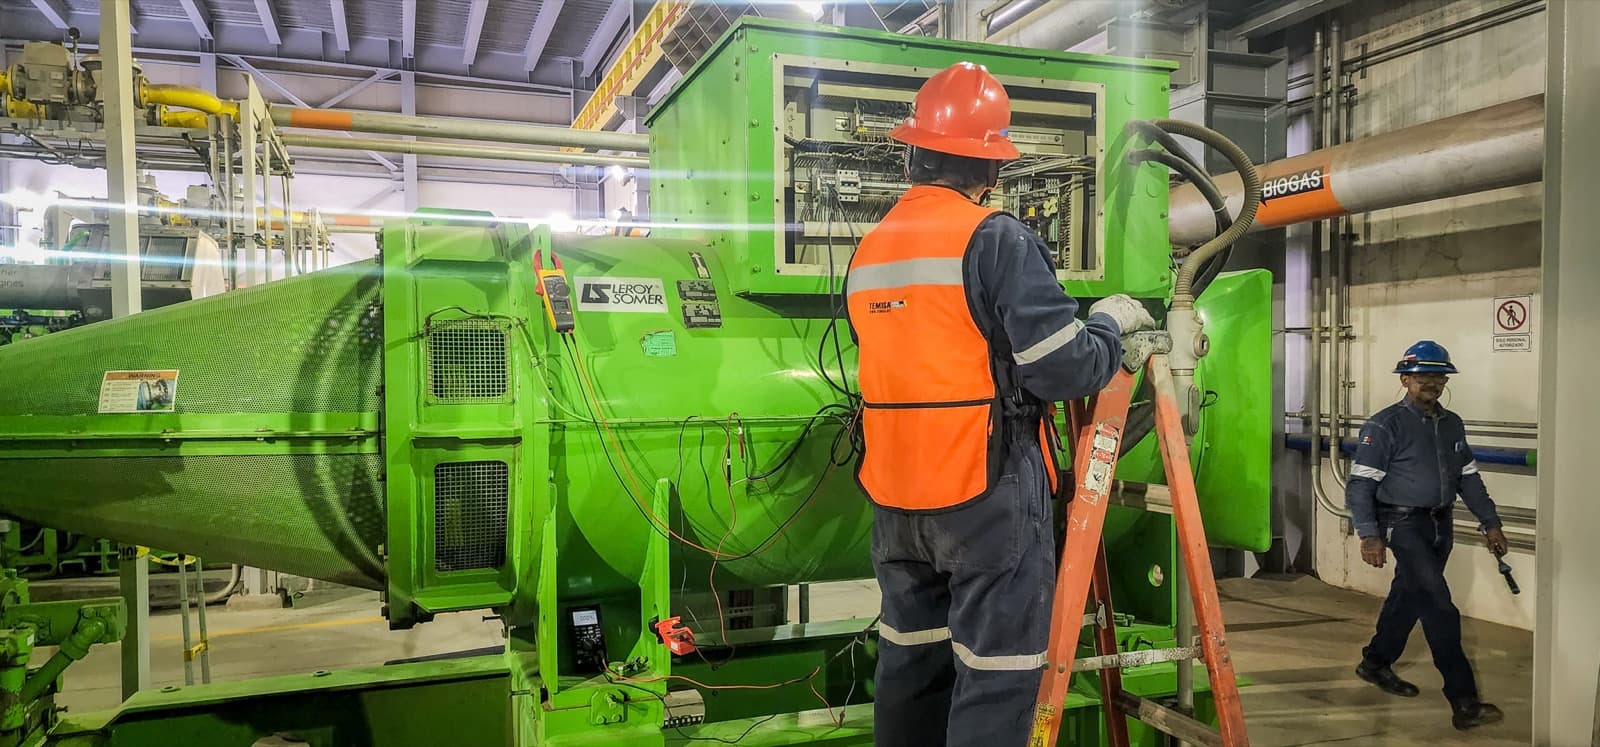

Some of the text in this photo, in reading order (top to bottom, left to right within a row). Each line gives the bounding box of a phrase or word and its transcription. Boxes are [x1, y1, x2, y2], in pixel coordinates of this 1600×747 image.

[1263, 170, 1321, 198] BIOGAS
[612, 284, 654, 295] LEROY
[612, 293, 664, 305] SOMER
